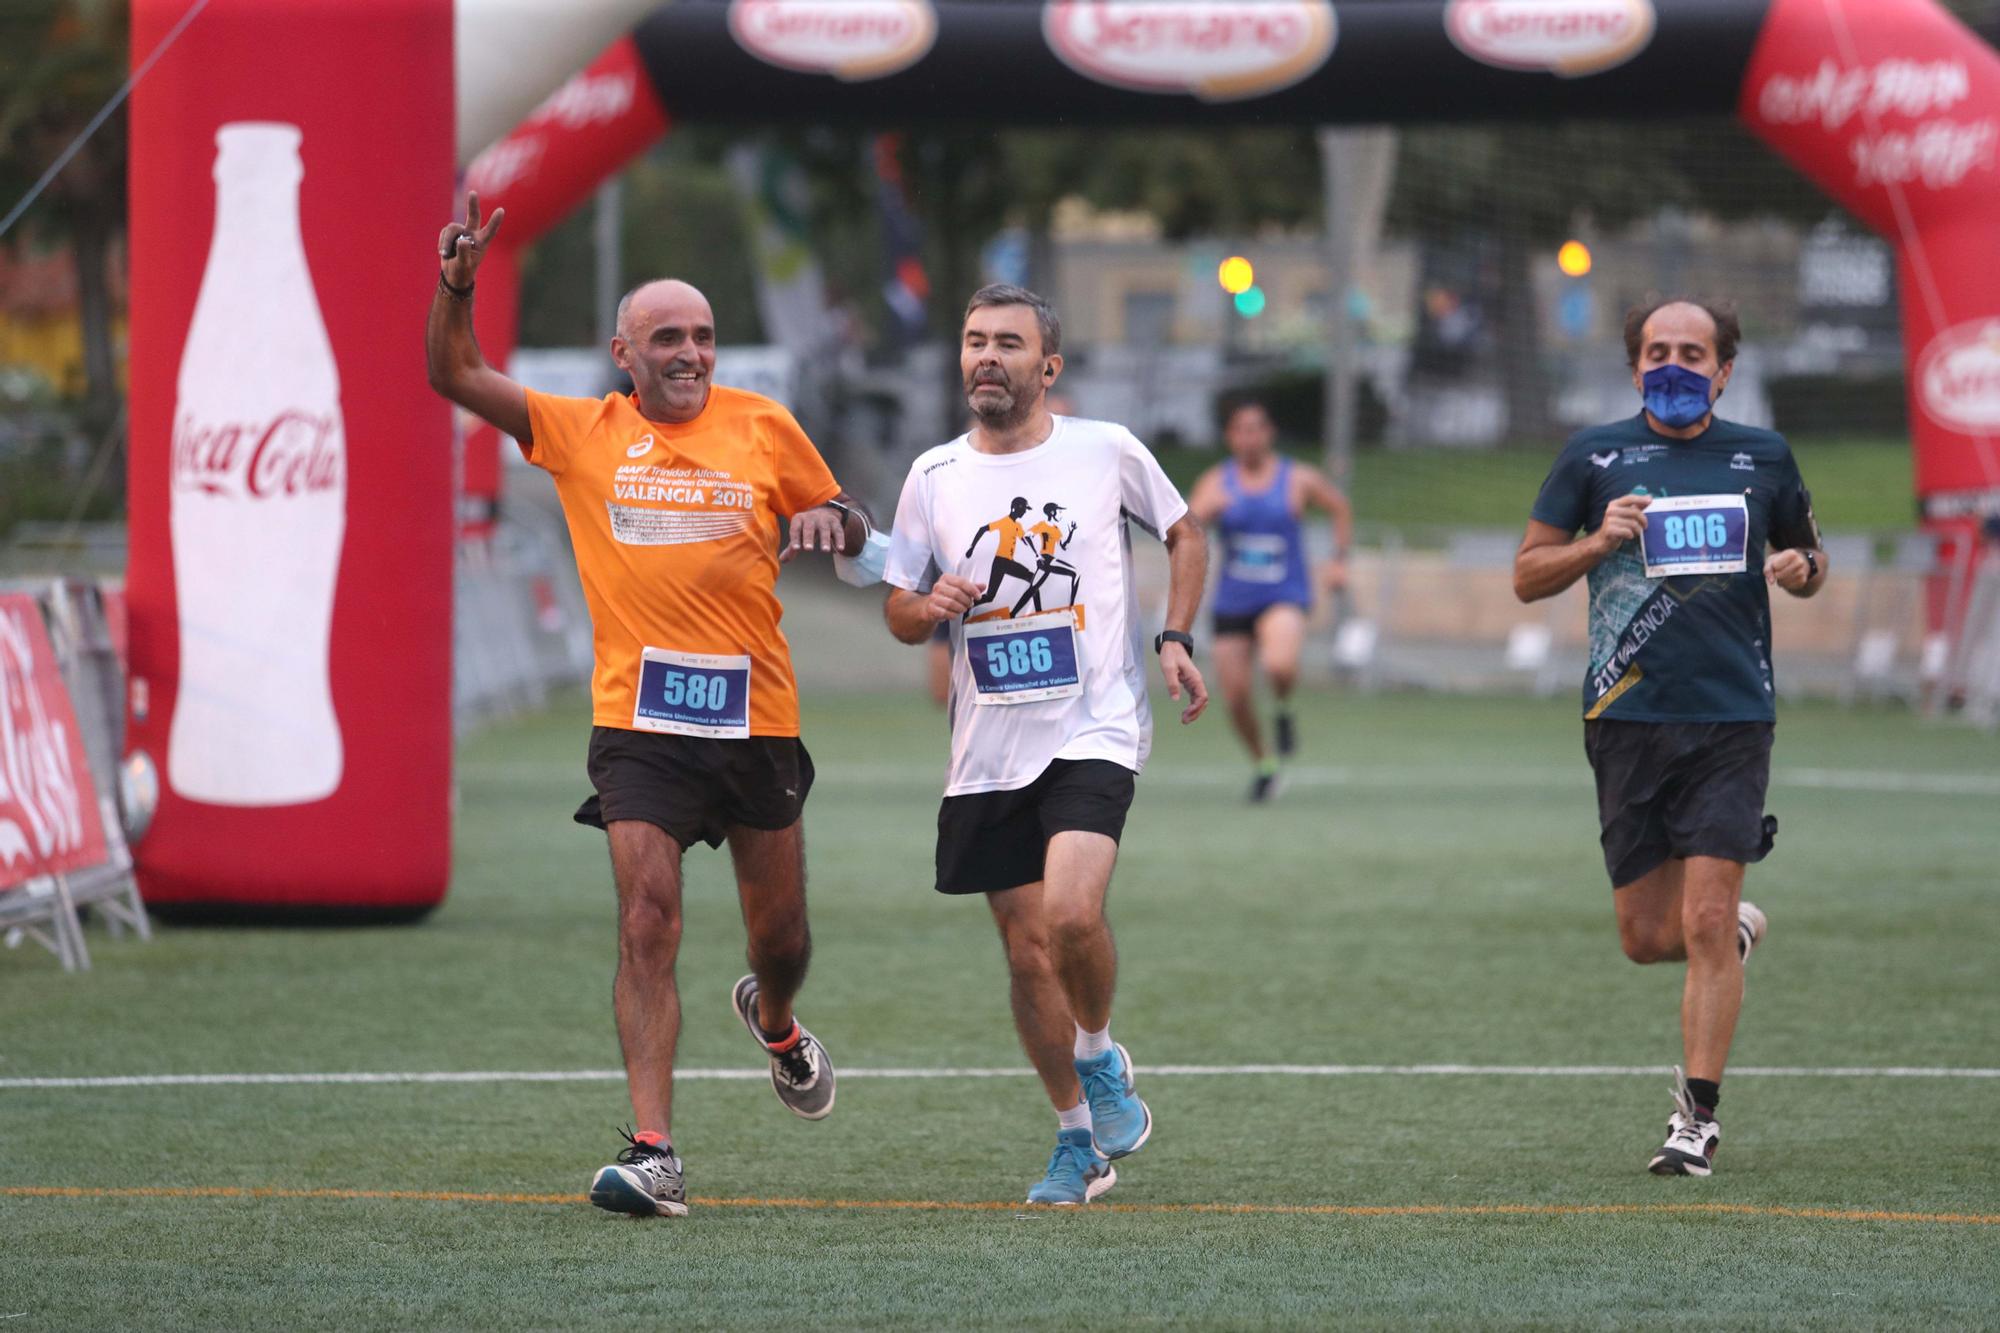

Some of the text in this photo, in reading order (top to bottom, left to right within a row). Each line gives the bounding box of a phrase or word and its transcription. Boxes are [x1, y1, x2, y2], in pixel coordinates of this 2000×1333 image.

[615, 474, 637, 482] World
[656, 477, 695, 487] Marathon
[651, 467, 690, 477] Trinidad
[694, 470, 730, 479] Alfonso
[613, 484, 753, 509] VALENCIA 2018
[1664, 513, 1727, 550] 806
[986, 636, 1053, 678] 586
[1593, 656, 1623, 698] 21K
[1616, 593, 1679, 666] VALÈNCIA
[664, 671, 728, 711] 580
[1004, 680, 1039, 690] Universitat
[648, 708, 673, 719] Carrera
[674, 711, 709, 724] Universitat
